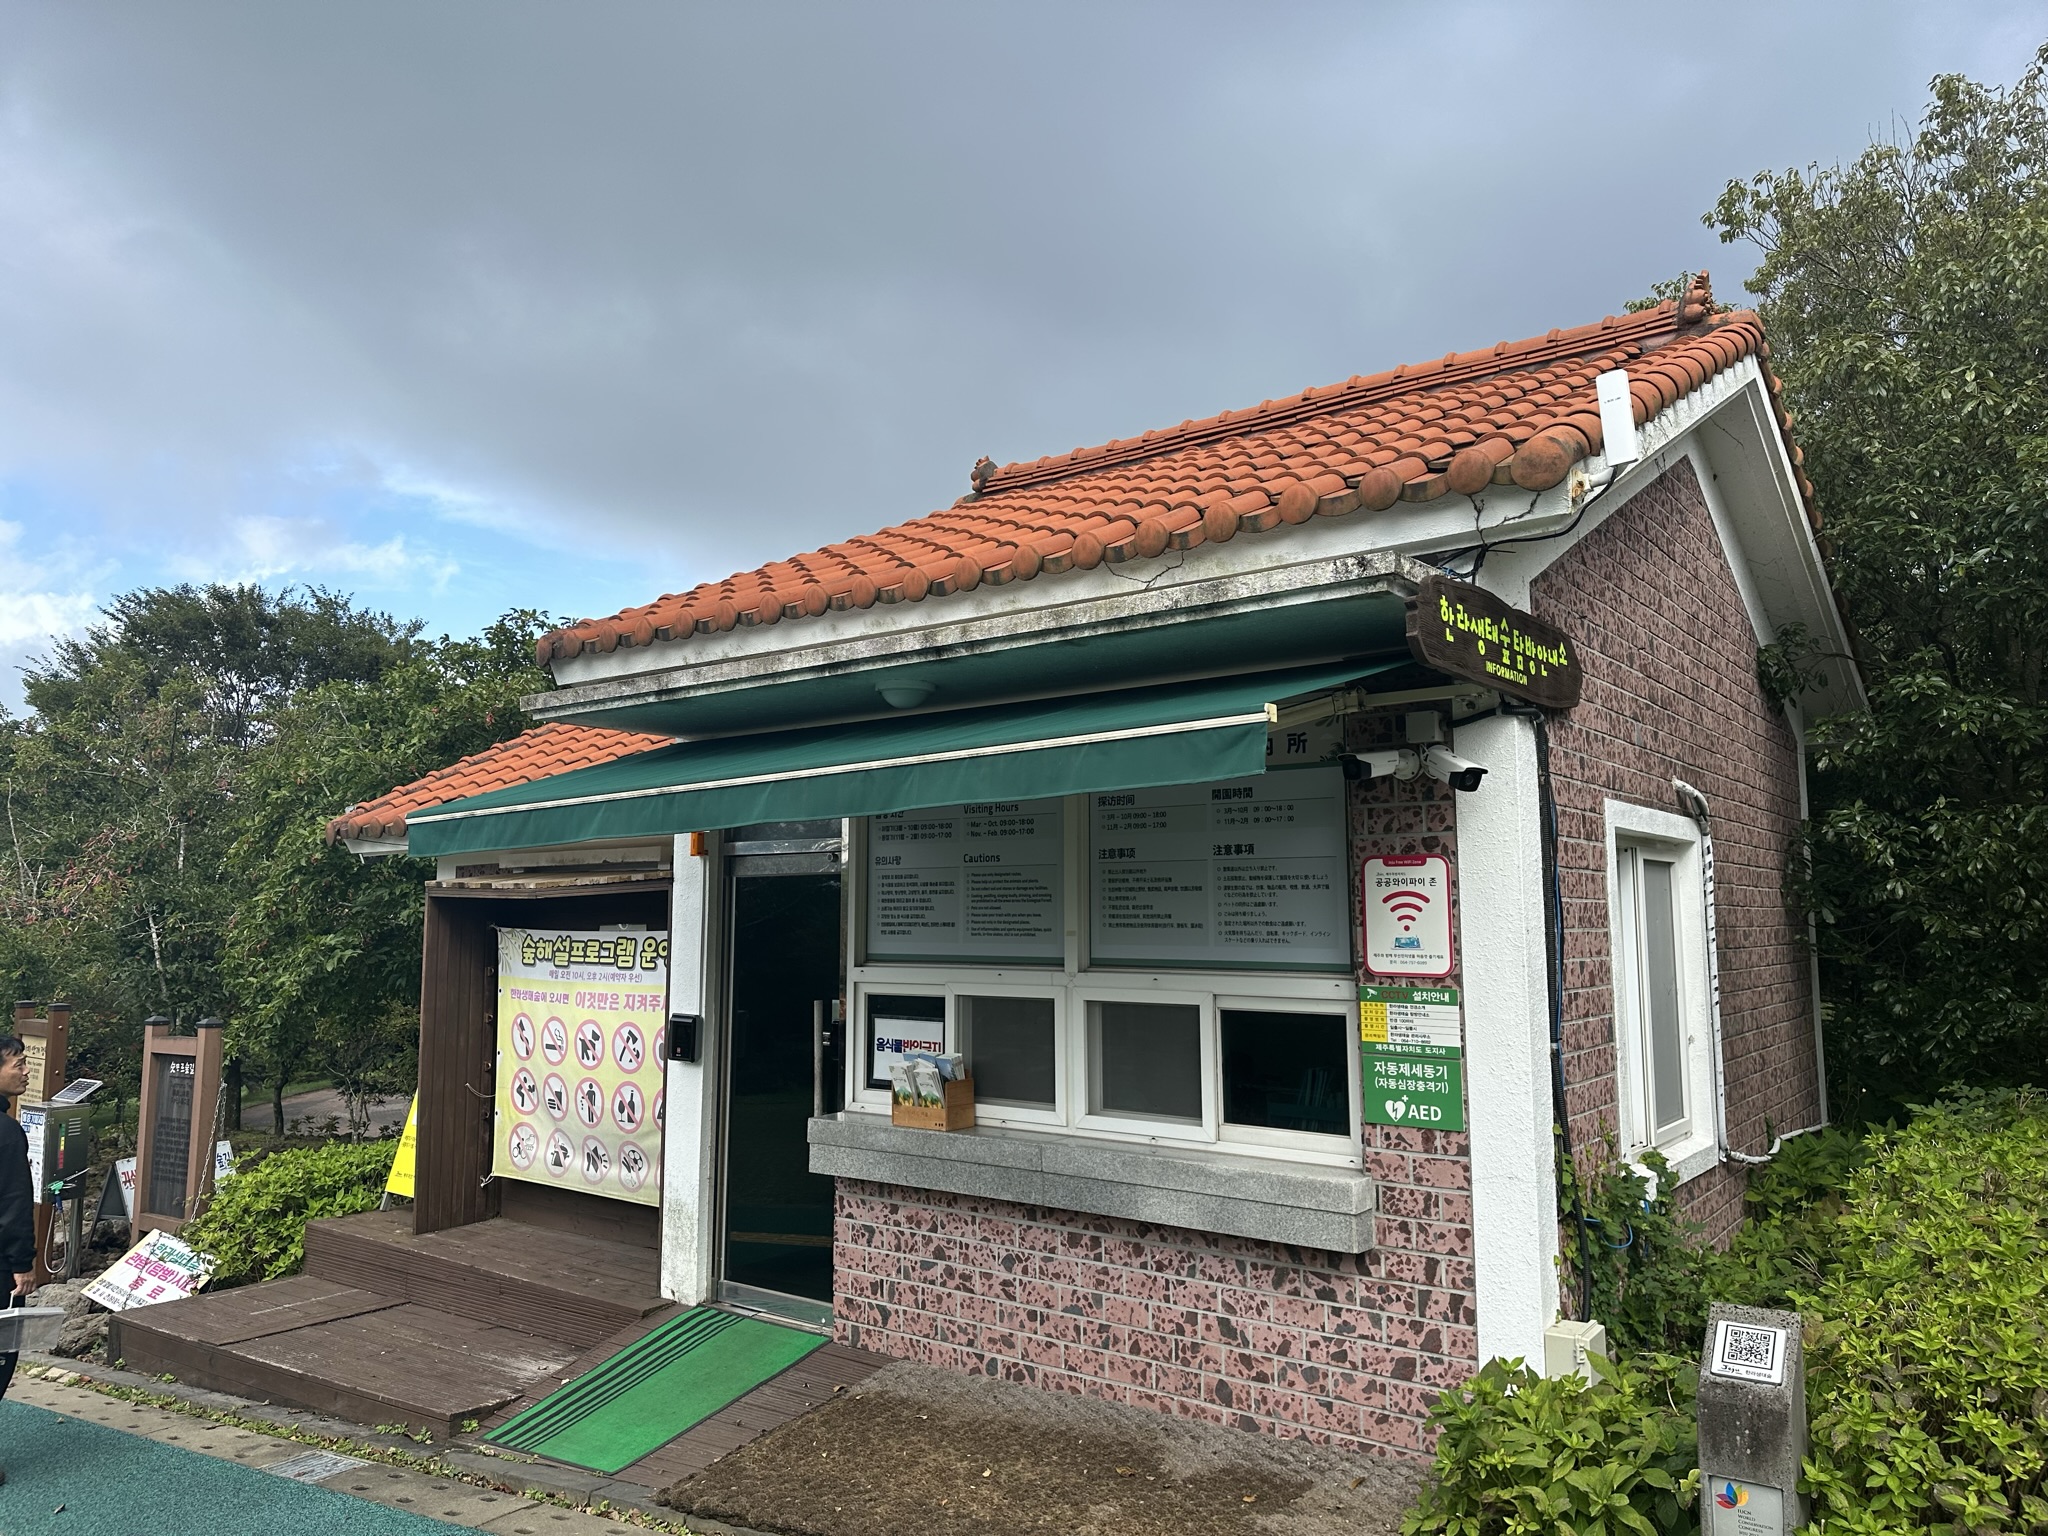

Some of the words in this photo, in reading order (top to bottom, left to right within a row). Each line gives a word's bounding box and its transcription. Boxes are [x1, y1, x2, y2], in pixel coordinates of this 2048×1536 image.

[1485, 660, 1527, 686] INFORMATION
[963, 804, 994, 815] Visiting
[995, 803, 1019, 813] Hours
[1098, 847, 1136, 860] 注意事项
[1212, 844, 1255, 856] 注意事項
[875, 856, 901, 866] 유의사항
[963, 853, 1001, 863] Cautions
[1375, 877, 1426, 888] 공공와이파이
[1428, 877, 1438, 887] 존
[521, 934, 637, 970] 숲해설프로그램
[549, 969, 559, 978] 매일
[560, 970, 571, 979] 오전
[586, 972, 597, 981] 오후
[510, 988, 547, 1003] 한라생태숲에
[549, 992, 569, 1005] 오시면
[575, 991, 620, 1011] 이것만은
[1381, 990, 1409, 999] CCTV
[1412, 991, 1450, 1003] 설치안내
[1376, 1044, 1422, 1054] 제주특별자치도
[1425, 1045, 1446, 1055] 도지사
[1373, 1061, 1448, 1080] 자동제세동기
[1374, 1077, 1449, 1095] (자동심장충격기)
[1407, 1105, 1442, 1121] AED
[1745, 1370, 1772, 1379] 한라생태숲
[1737, 1514, 1756, 1522] WORLD
[1737, 1519, 1774, 1531] CONSERVATION
[1738, 1524, 1764, 1533] CONGRESS
